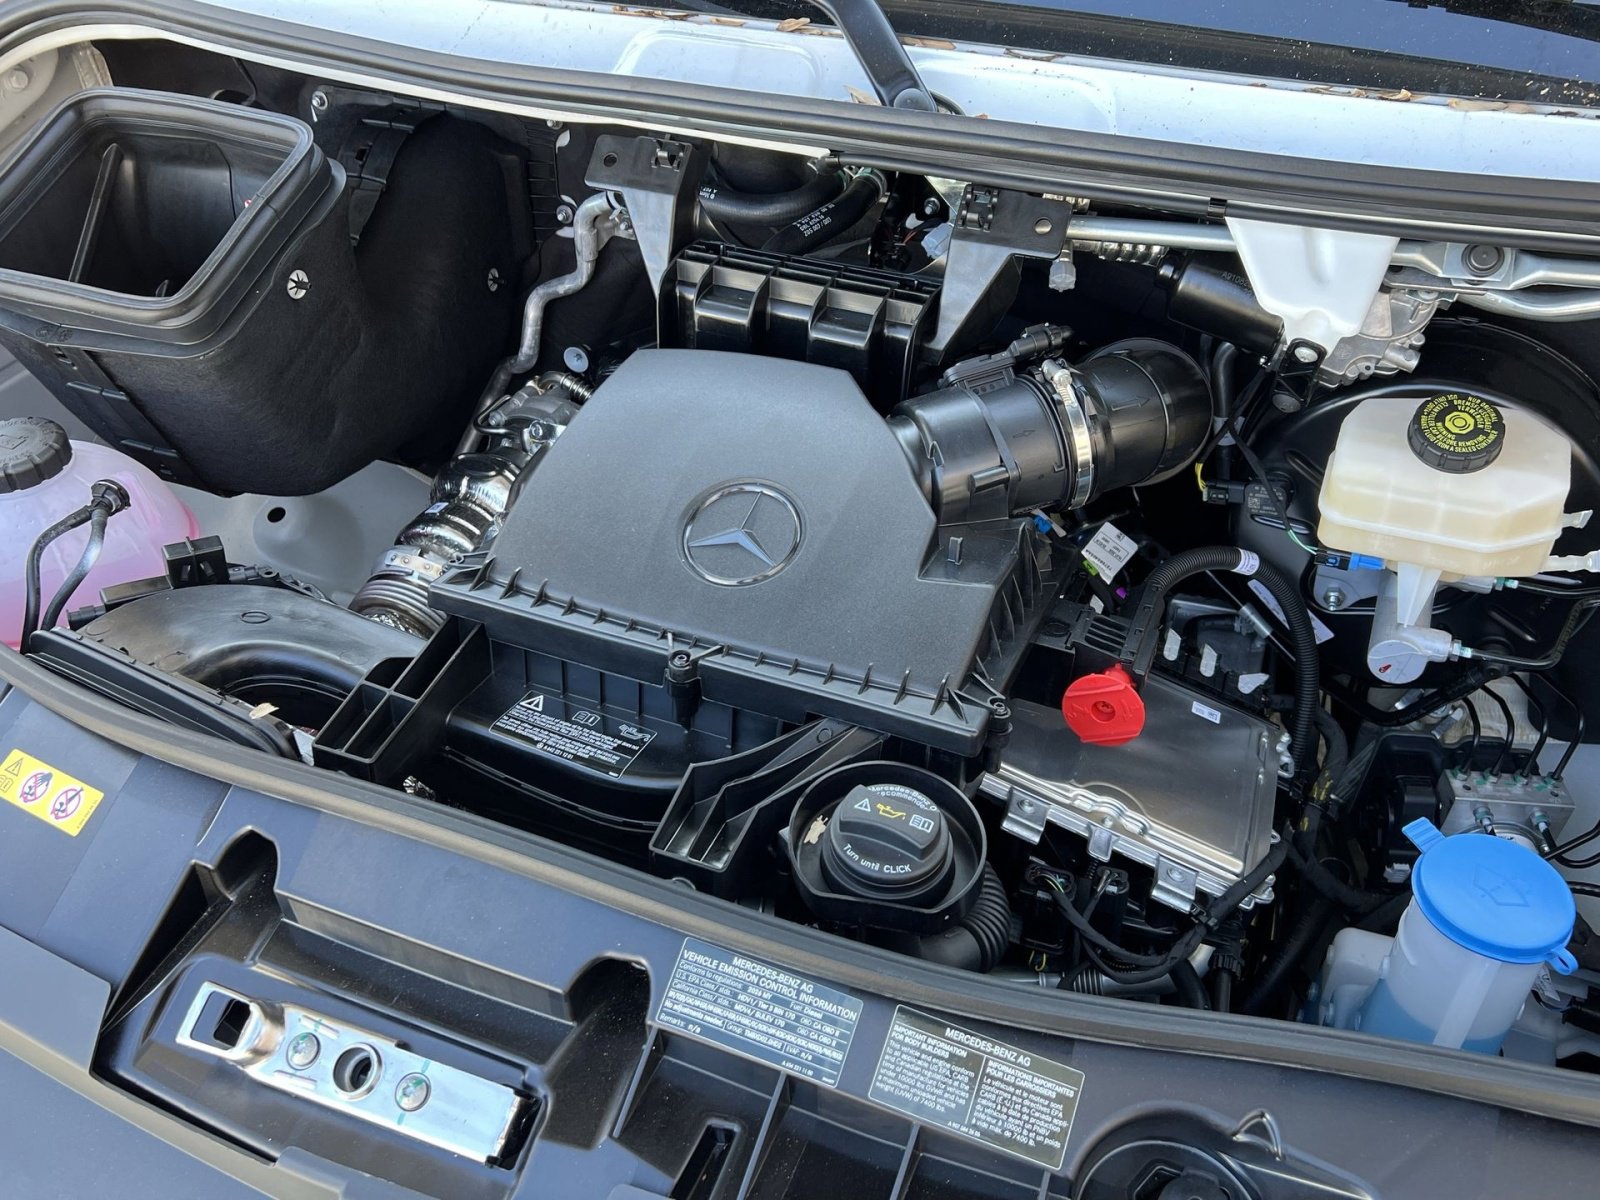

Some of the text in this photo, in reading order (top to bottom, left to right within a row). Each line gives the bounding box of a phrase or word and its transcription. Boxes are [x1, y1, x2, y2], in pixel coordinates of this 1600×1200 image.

[843, 843, 912, 874] Turn until CLICK
[682, 948, 857, 1020] VEHICLE EMISSION CONTROL INFORMATION
[731, 956, 814, 994] MERCEDES-BENZ AG
[803, 1006, 823, 1019] Diesel
[890, 1031, 950, 1058] FOR BODY BUILDERS
[893, 1024, 968, 1058] IMPORTANT INFORMATION
[944, 1026, 1031, 1067] MERCEDES-BENZ AG
[985, 1066, 1056, 1099] POUR LES CARROSSIERS
[987, 1059, 1074, 1098] INFORMATIONS IMPORTANTES
